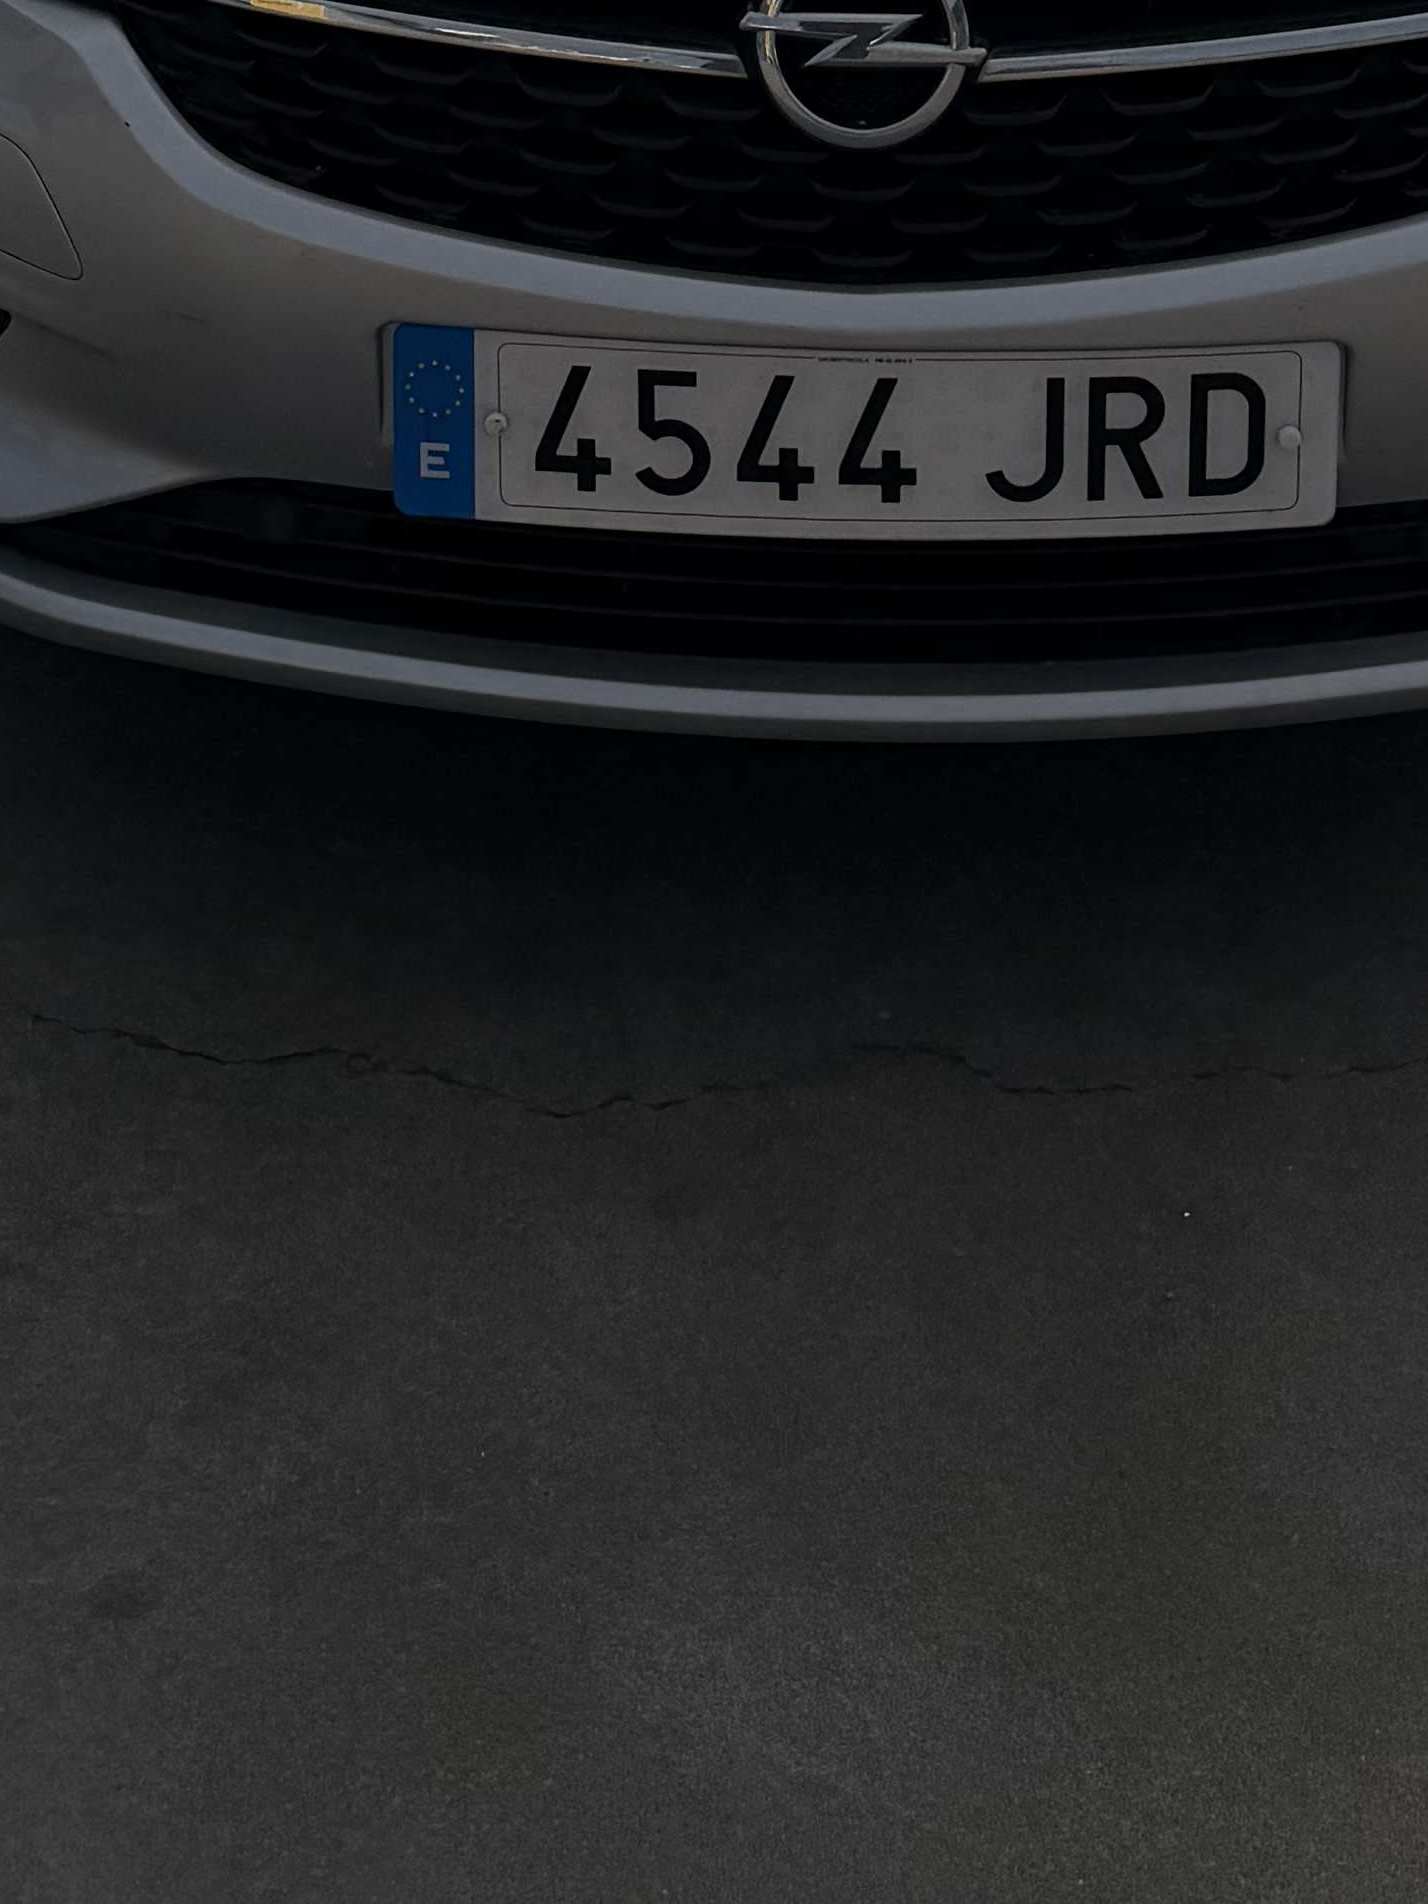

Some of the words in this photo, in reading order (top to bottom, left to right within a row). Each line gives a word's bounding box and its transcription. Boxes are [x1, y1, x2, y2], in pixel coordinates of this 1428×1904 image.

[420, 441, 451, 479] E
[534, 365, 918, 504] 4544
[984, 372, 1266, 503] JRD
